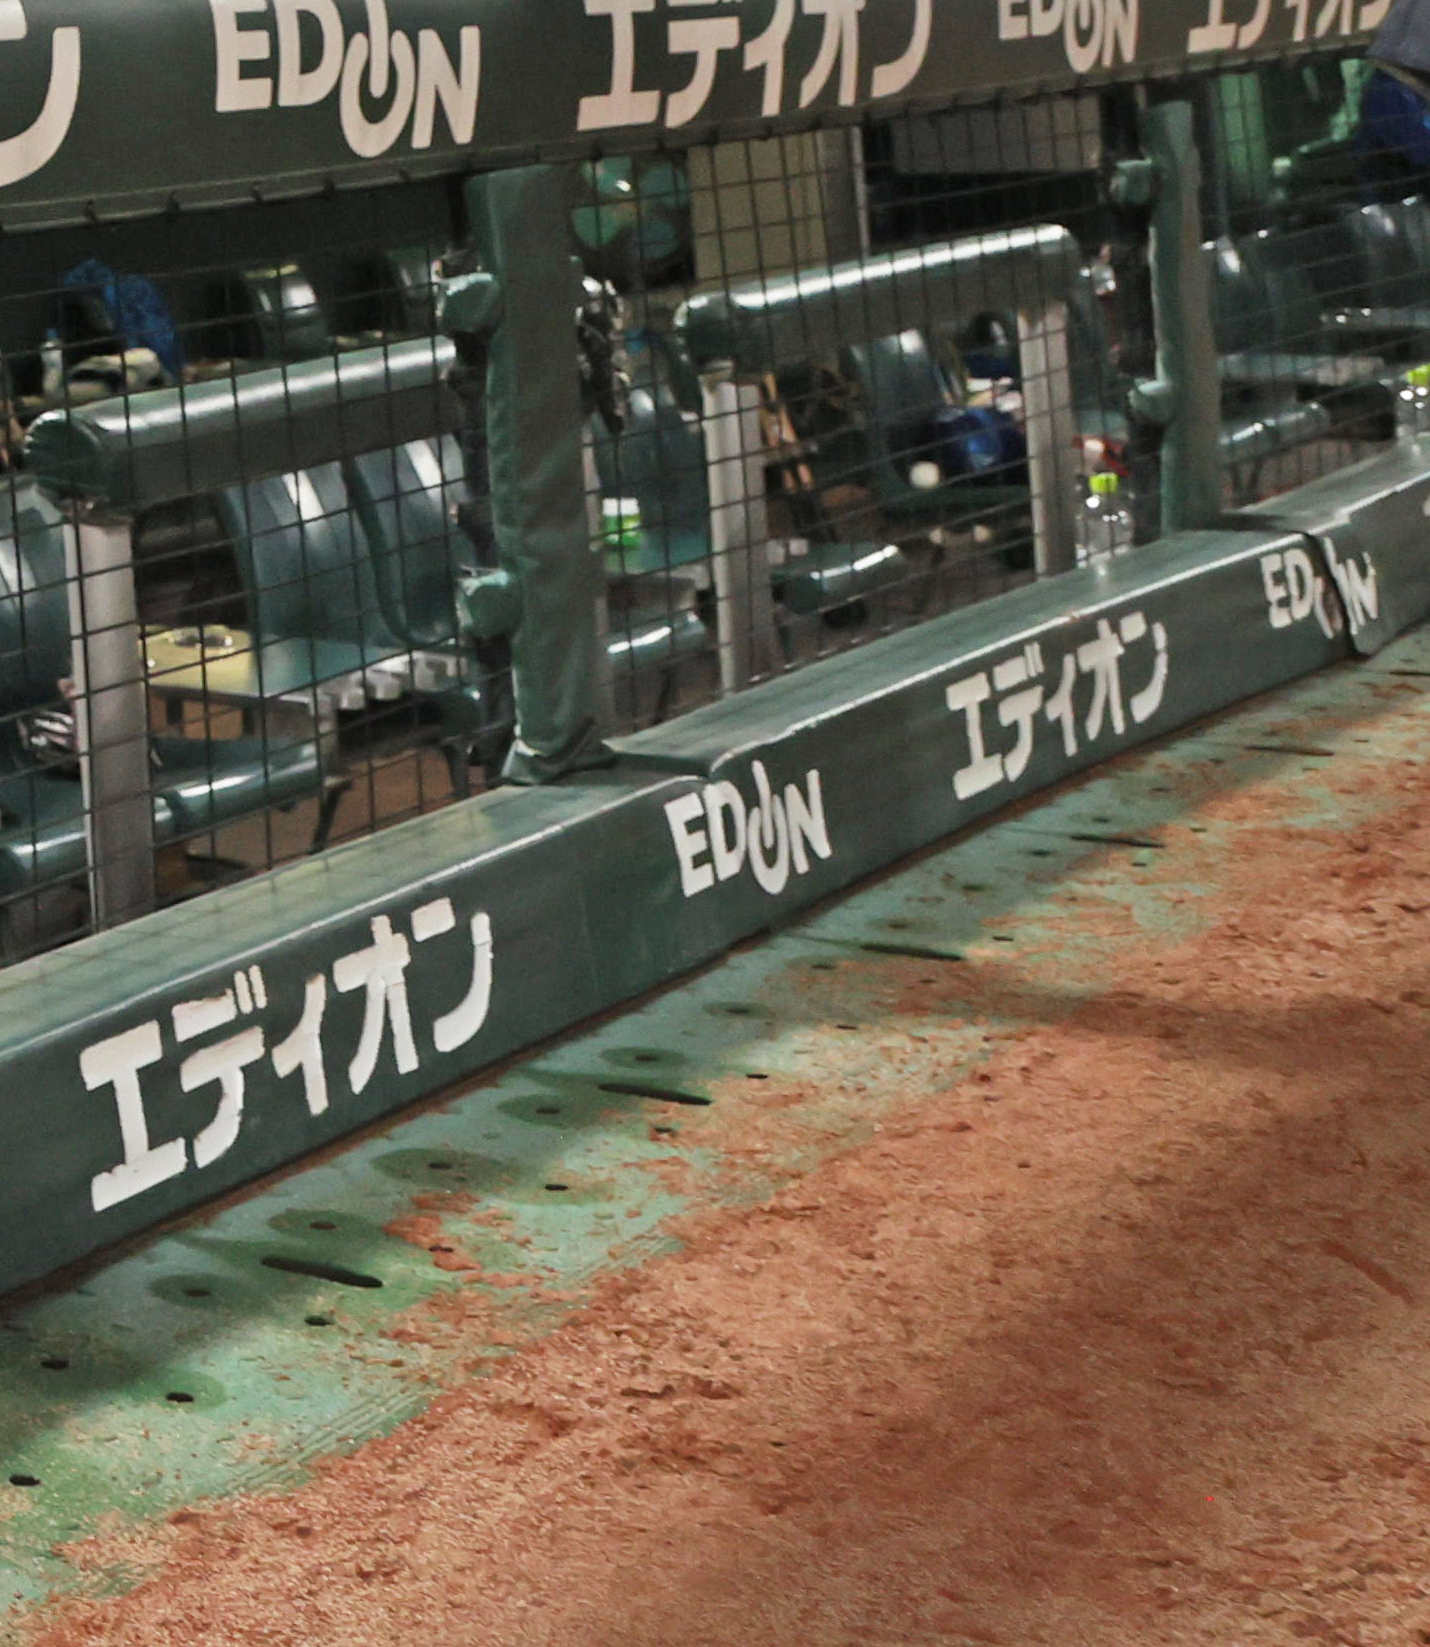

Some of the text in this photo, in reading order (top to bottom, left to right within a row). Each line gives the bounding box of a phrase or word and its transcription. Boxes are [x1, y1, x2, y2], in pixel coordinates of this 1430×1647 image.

[946, 610, 1169, 802] エディオン
[79, 897, 493, 1212] エディオン
